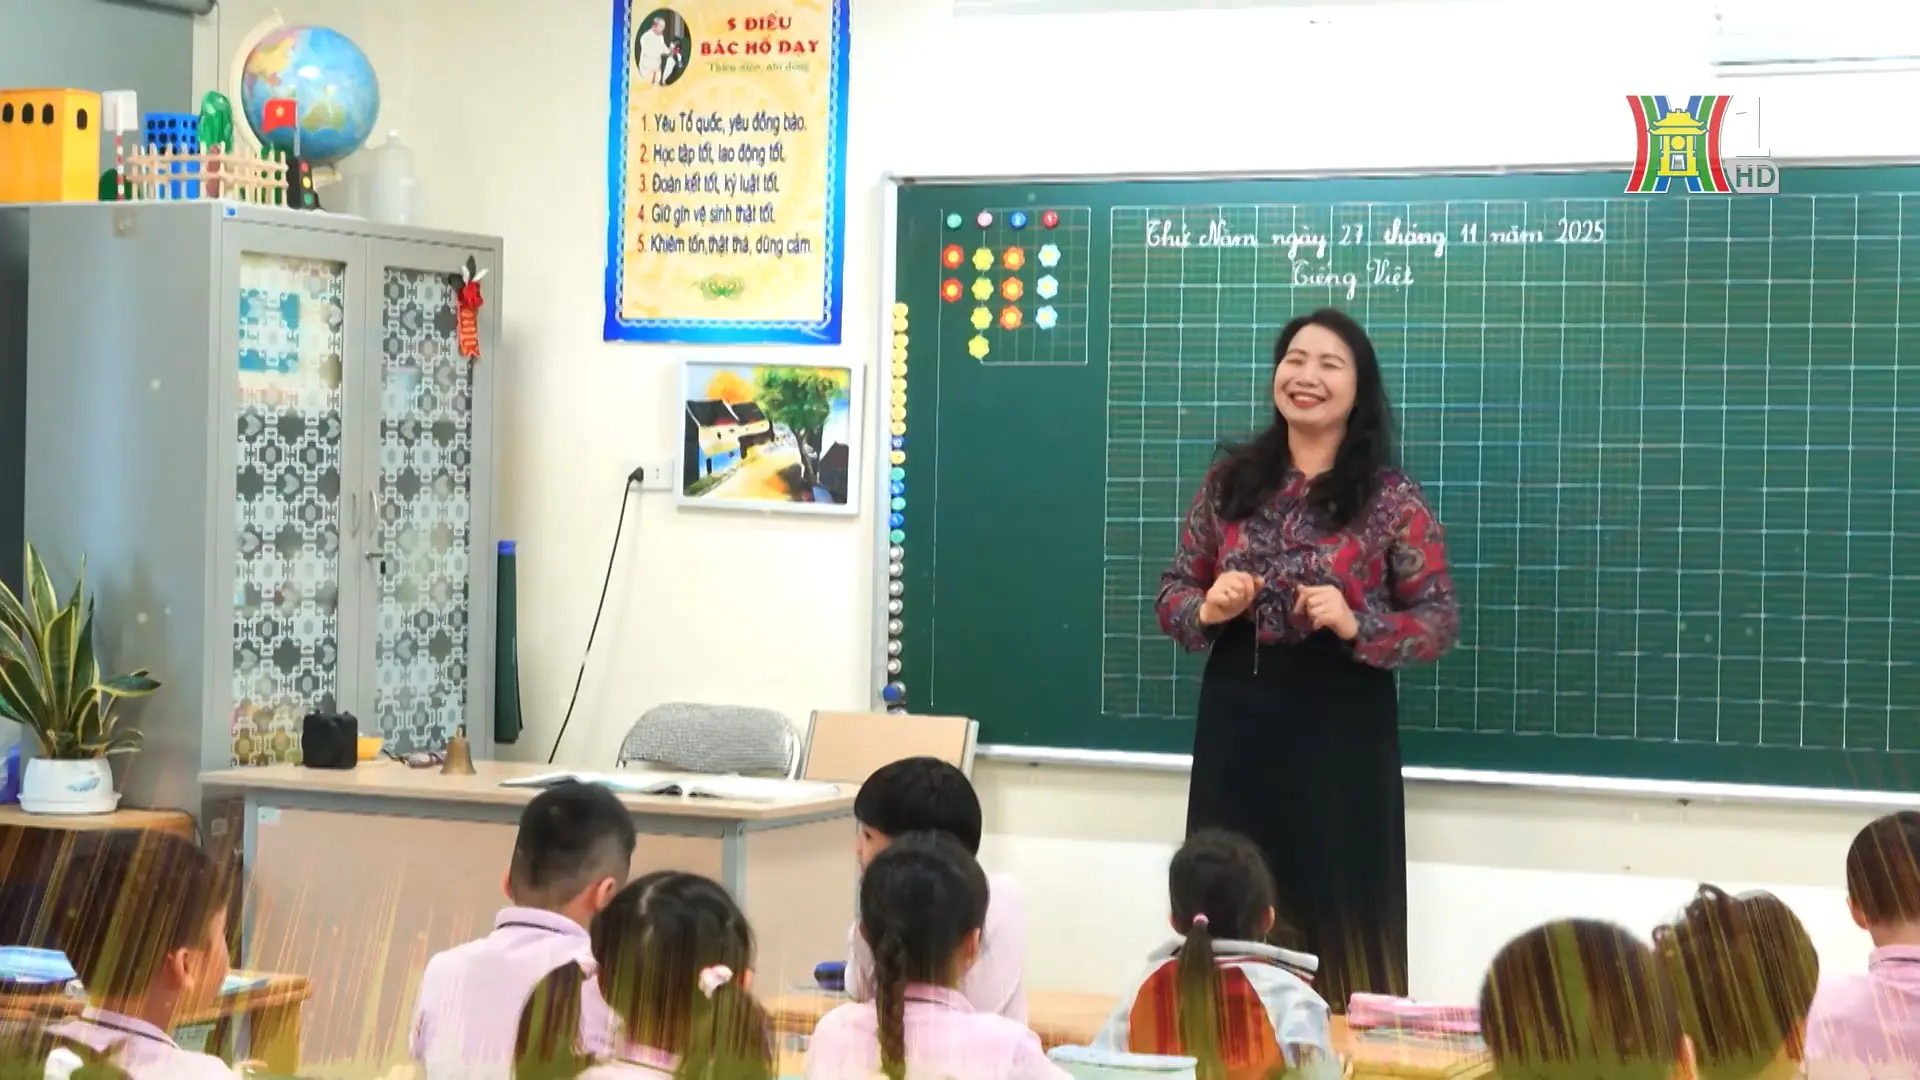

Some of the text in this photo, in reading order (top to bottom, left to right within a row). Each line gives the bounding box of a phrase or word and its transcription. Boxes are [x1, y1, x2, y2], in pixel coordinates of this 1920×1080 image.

[700, 38, 739, 56] BÁC
[654, 113, 676, 133] Yêu
[679, 109, 693, 132] Tổ
[729, 113, 749, 136] yêu
[653, 143, 676, 167] Học
[718, 143, 735, 162] lao
[738, 142, 766, 168] động
[693, 205, 706, 227] vệ
[709, 203, 732, 224] sinh
[1271, 224, 1327, 260] ngày
[1338, 223, 1363, 246] 27
[1383, 217, 1446, 258] tháng
[1460, 223, 1478, 244] 11
[1490, 225, 1544, 244] năm
[1556, 217, 1606, 243] 2025
[1292, 257, 1414, 300] Tiếng Việt
